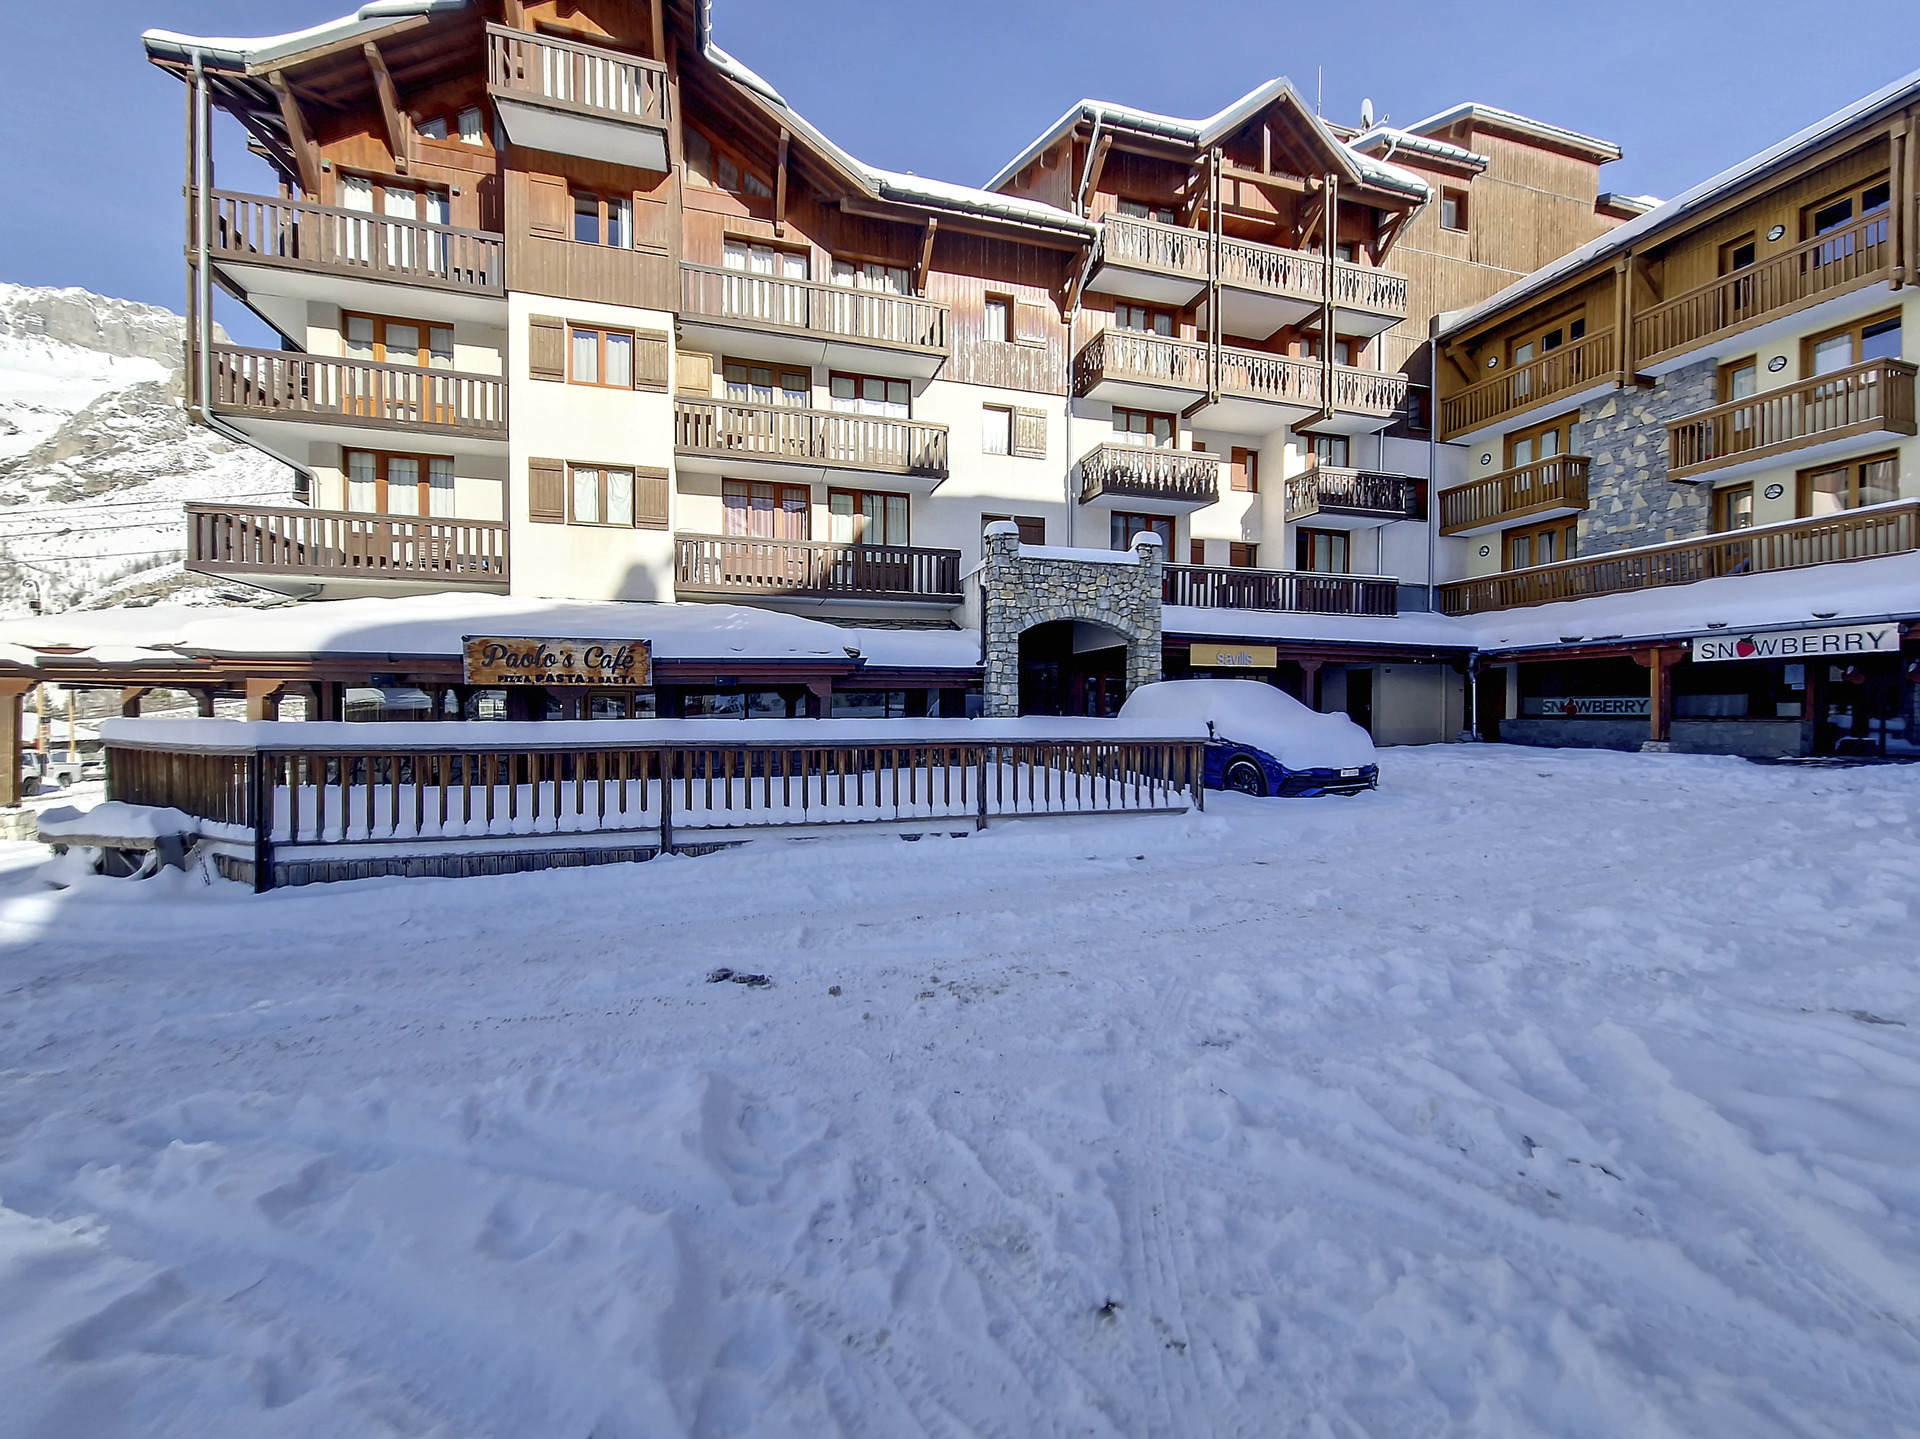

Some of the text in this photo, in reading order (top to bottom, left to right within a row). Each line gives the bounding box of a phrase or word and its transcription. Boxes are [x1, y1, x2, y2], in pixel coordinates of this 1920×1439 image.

[481, 643, 634, 674] Paolo's Café
[1216, 651, 1254, 665] savills
[536, 674, 586, 683] PASTA
